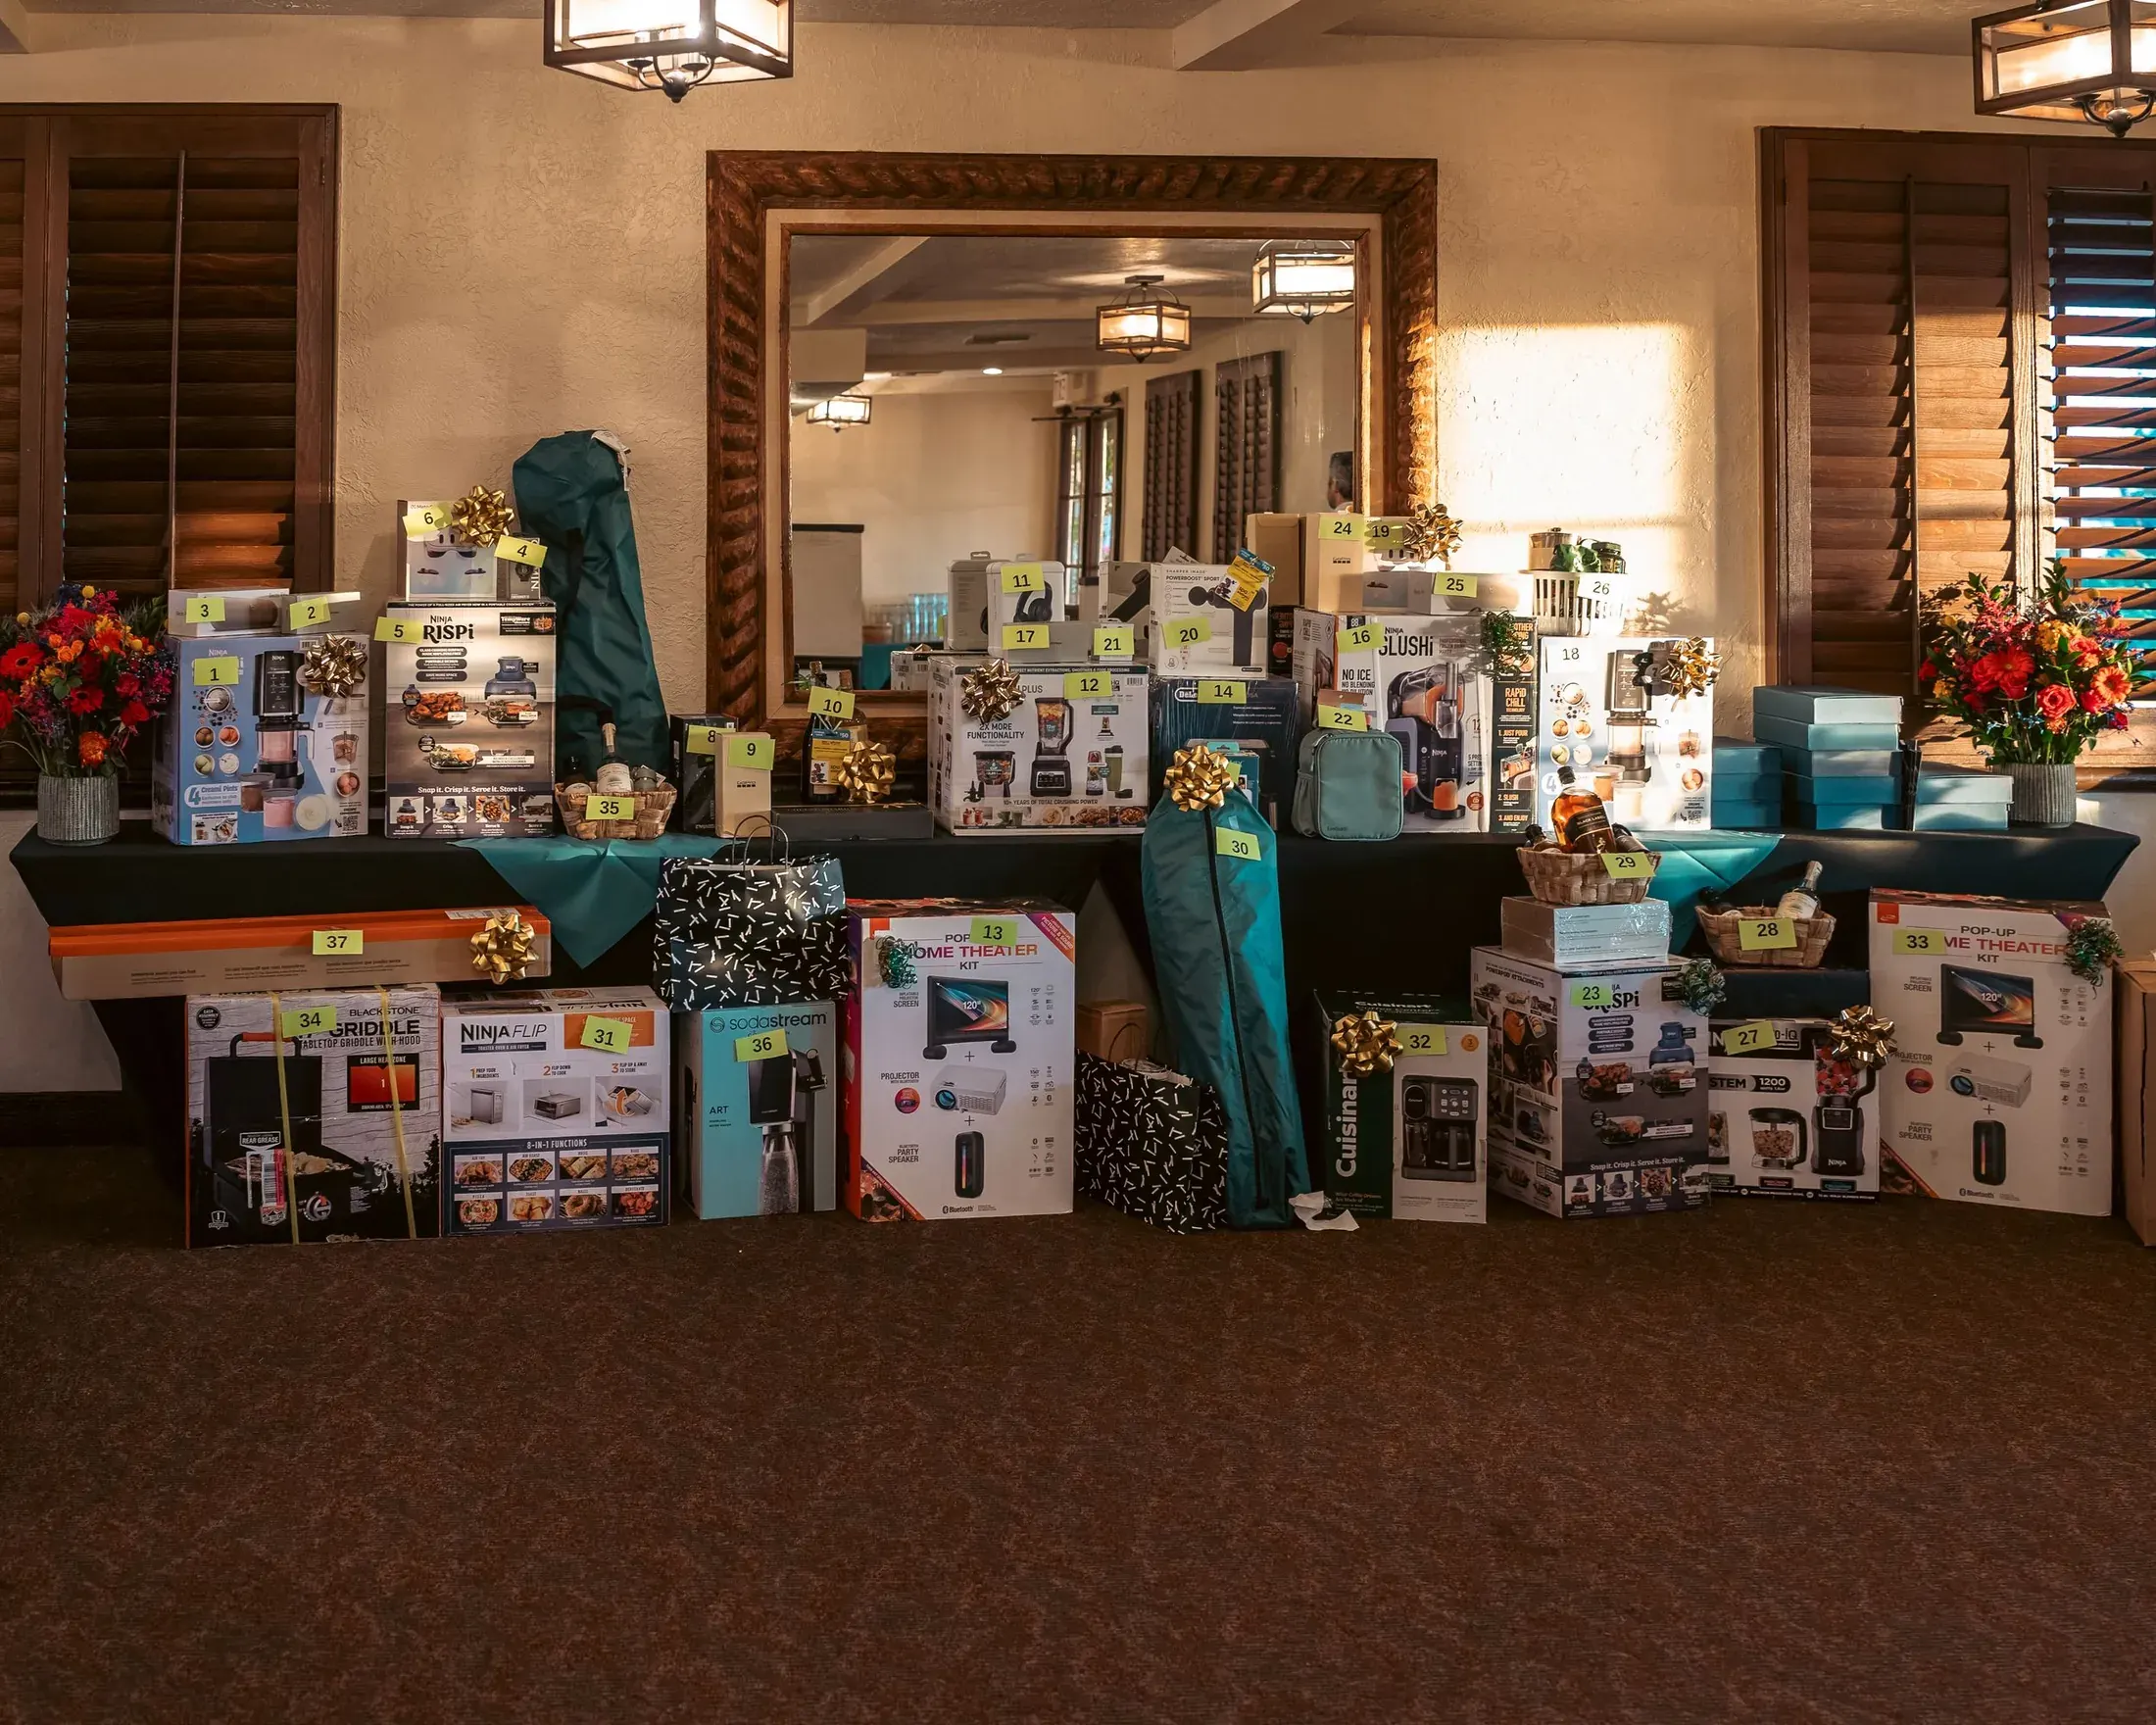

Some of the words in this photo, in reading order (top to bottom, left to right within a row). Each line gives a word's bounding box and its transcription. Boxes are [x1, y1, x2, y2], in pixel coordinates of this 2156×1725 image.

[423, 512, 434, 525] 6
[1334, 521, 1352, 535] 24
[1372, 525, 1390, 538] 19
[516, 544, 528, 558] 4
[1011, 573, 1031, 588] 11
[1446, 577, 1464, 592] 25
[1592, 580, 1610, 595] 26
[200, 604, 209, 617] 3
[307, 607, 317, 619] 2
[429, 615, 453, 624] NINJA
[394, 624, 404, 638] 5
[422, 623, 474, 644] RISPi
[1016, 630, 1035, 643] 17
[1179, 627, 1199, 643] 20
[1351, 629, 1371, 645] 16
[1385, 626, 1404, 638] NINJA
[1103, 637, 1122, 651] 21
[1379, 635, 1433, 657] SLUSHi
[1562, 647, 1580, 661] 18
[210, 667, 220, 681] 1
[1342, 668, 1354, 680] NO
[1356, 668, 1372, 680] ICE
[1080, 677, 1100, 692] 12
[1213, 684, 1234, 698] 14
[822, 699, 843, 714] 10
[991, 722, 1012, 731] MORE
[1334, 713, 1353, 726] 22
[708, 729, 716, 743] 8
[966, 731, 1025, 740] FUNCTIONALITY
[747, 743, 757, 757] 9
[1545, 775, 1558, 793] 4
[188, 786, 202, 806] 4
[600, 801, 619, 814] 35
[1232, 840, 1249, 856] 30
[1615, 857, 1636, 868] 29
[1041, 915, 1058, 933] PICTURE
[1756, 922, 1779, 938] 28
[1960, 925, 2016, 937] POP-UP
[945, 934, 970, 943] POP
[982, 924, 1004, 940] 13
[326, 935, 348, 949] 37
[1906, 935, 1929, 949] 33
[1944, 936, 1971, 949] ME
[1976, 938, 2066, 956] THEATER
[959, 944, 1038, 958] THEATER
[1977, 954, 2000, 963] KIT
[959, 961, 980, 971] KIT
[1582, 986, 1600, 1001] 23
[1903, 983, 1933, 993] SCREEN
[299, 1011, 321, 1028] 34
[729, 1012, 827, 1031] sodastream
[329, 1019, 420, 1038] GRIDDLE
[461, 1022, 511, 1044] NINJA
[512, 1023, 548, 1038] FLIP
[300, 1039, 338, 1050] TABLETOP
[340, 1037, 374, 1047] GRIDDLE
[399, 1035, 420, 1046] HOOD
[593, 1028, 614, 1047] 31
[752, 1036, 772, 1053] 36
[1409, 1034, 1432, 1049] 32
[1738, 1029, 1758, 1046] 27
[469, 1068, 476, 1078] 1
[543, 1065, 552, 1076] 2
[612, 1062, 619, 1073] 3
[381, 1078, 385, 1088] 1
[1709, 1077, 1746, 1089] STEM
[709, 1105, 729, 1114] ART
[1336, 1067, 1357, 1177] Cuisinart
[551, 1139, 587, 1148] FUNCTIONS
[1898, 1132, 1933, 1141] SPEAKER
[1966, 1189, 1994, 1199] Bluetooth
